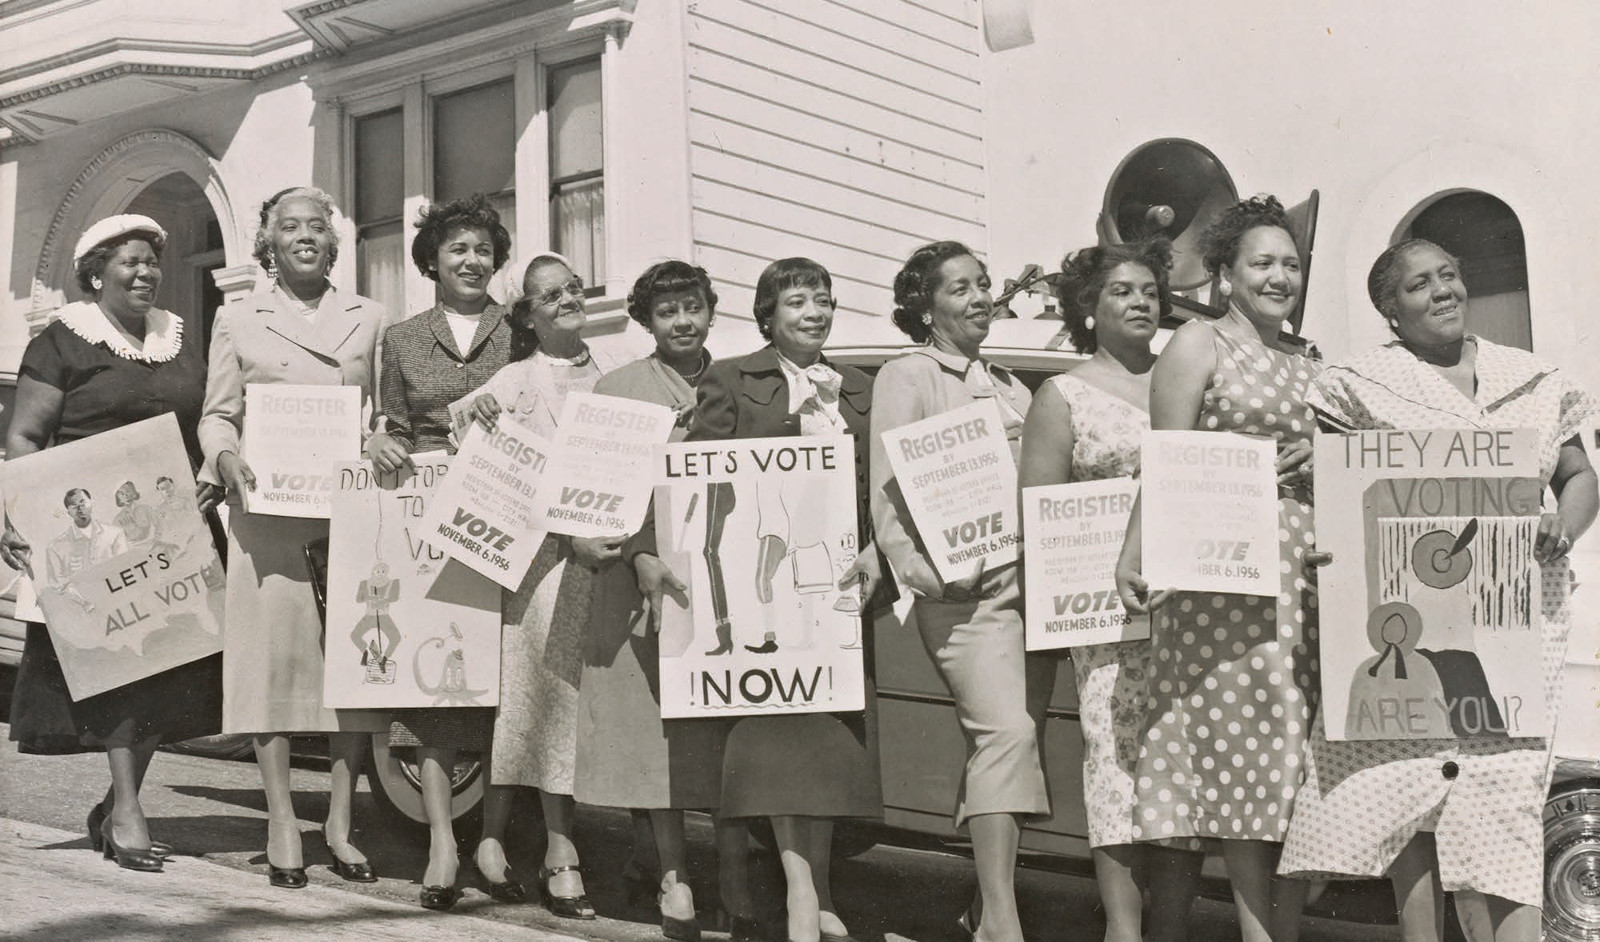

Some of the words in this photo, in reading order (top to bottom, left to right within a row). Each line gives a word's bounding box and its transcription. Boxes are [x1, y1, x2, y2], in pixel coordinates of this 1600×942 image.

[261, 393, 346, 417] REGISTER
[574, 403, 658, 432] REGISTER
[481, 432, 548, 474] EGIST
[899, 418, 991, 462] REGISTER
[1340, 431, 1433, 468] THEY
[1445, 431, 1514, 467] ARE
[508, 462, 522, 474] BY
[665, 450, 738, 478] LET'S
[750, 446, 837, 473] VOTE
[943, 453, 955, 464] BY
[1159, 441, 1260, 470] REGISTER
[271, 473, 333, 491] VOTE
[469, 455, 522, 491] SEPTEMBER
[912, 462, 969, 490] SEPTEMBER
[263, 491, 311, 504] NOVEMBER
[396, 495, 424, 518] TO
[560, 486, 626, 513] VOTE
[1039, 493, 1132, 522] REGISTER
[1388, 477, 1535, 517] VOTING
[452, 506, 515, 552] VOTE
[547, 506, 593, 525] NOVEMBER
[1080, 521, 1092, 531] BY
[437, 523, 482, 556] NOVEMBER
[942, 511, 1003, 549] VOTE
[1040, 532, 1102, 550] SEPTEMBER
[947, 543, 990, 566] NOVEMBER
[1194, 539, 1251, 562] OTE
[104, 552, 171, 594] LET'S
[1052, 589, 1121, 616] VOTE
[104, 601, 151, 637] ALL
[1045, 616, 1097, 633] NOVEMBER
[1356, 697, 1428, 735] ARE
[1433, 695, 1524, 735] YOU?
